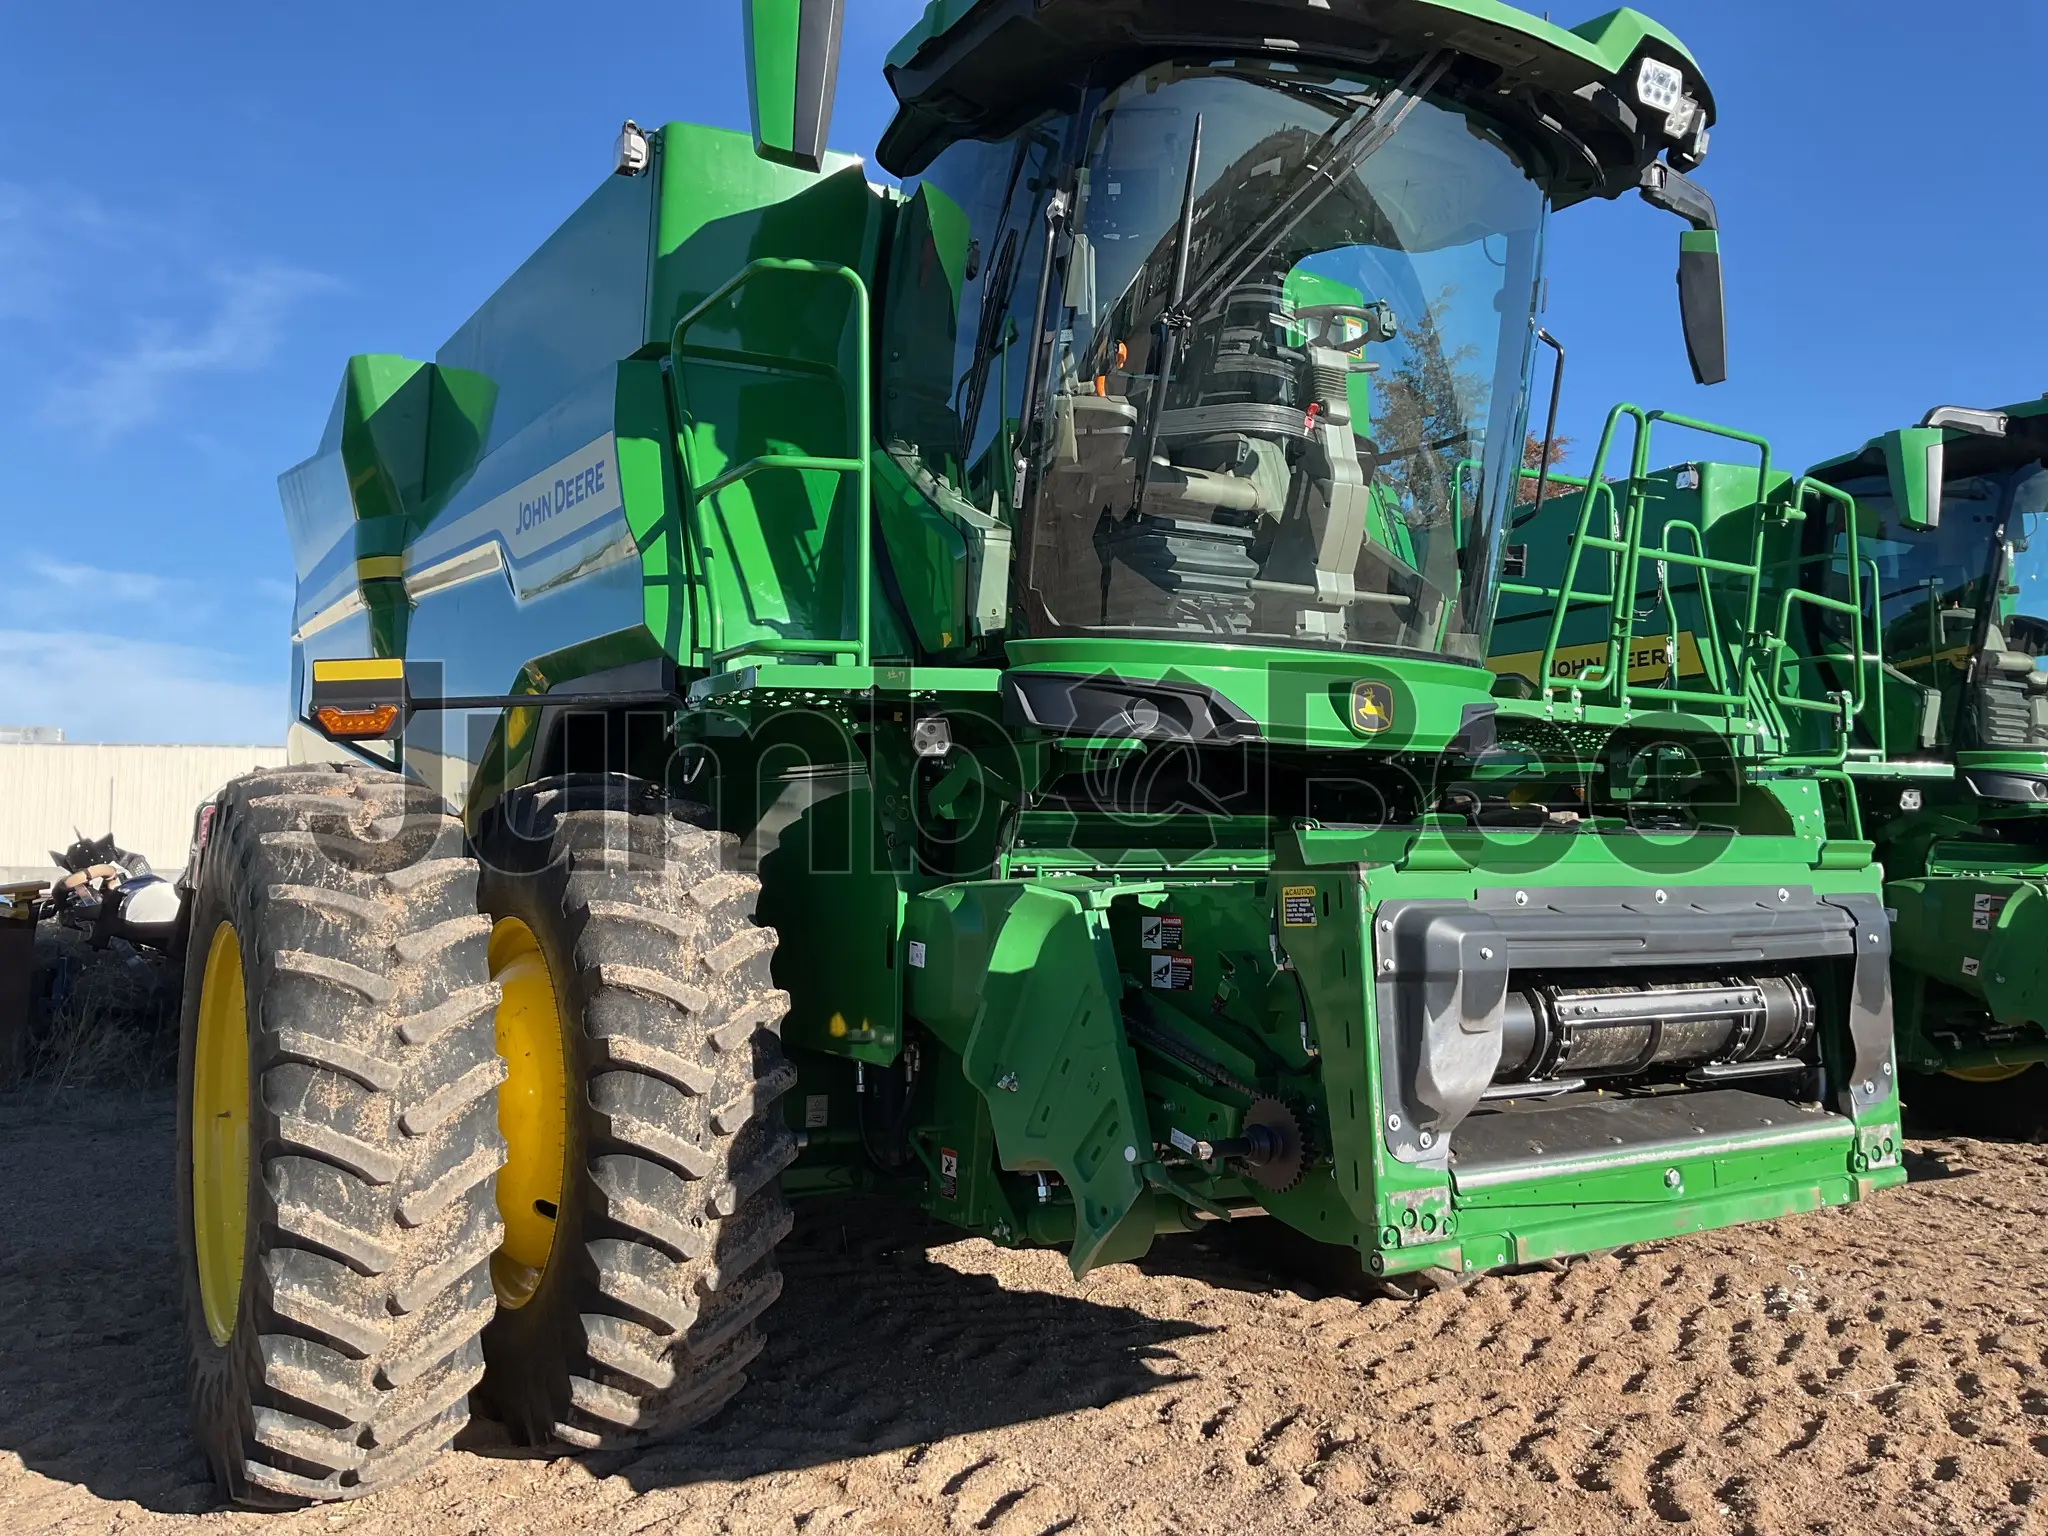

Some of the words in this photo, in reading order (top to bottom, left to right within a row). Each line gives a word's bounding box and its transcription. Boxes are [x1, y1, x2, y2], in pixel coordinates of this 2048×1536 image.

[515, 491, 552, 536] JOHN
[554, 460, 605, 515] DEERE
[1289, 888, 1315, 896] CAUTION
